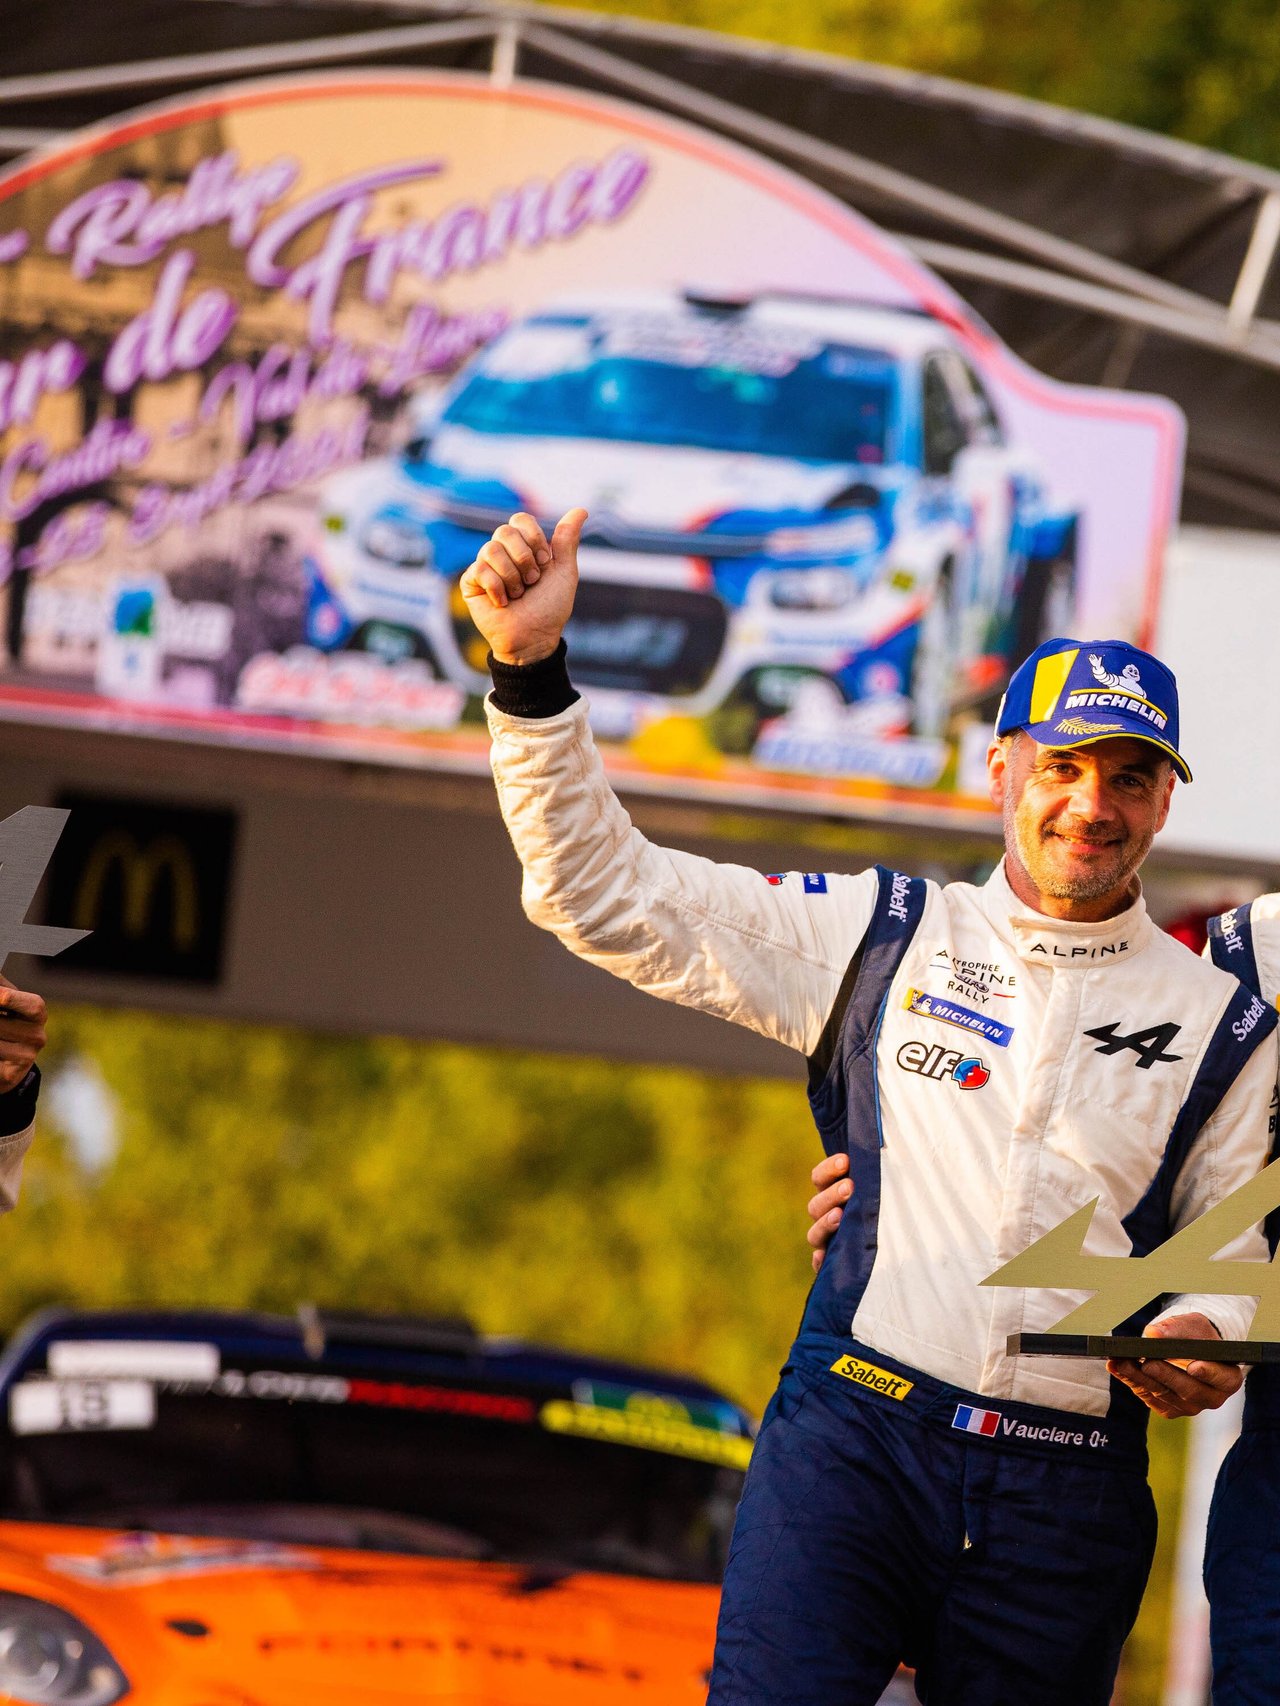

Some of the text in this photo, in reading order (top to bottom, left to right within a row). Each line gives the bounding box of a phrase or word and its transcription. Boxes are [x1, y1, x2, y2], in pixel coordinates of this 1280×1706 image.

[248, 161, 650, 348] France
[1065, 694, 1167, 731] MICHELIN
[1030, 941, 1129, 958] ALPINE
[947, 981, 990, 1004] RALLY
[932, 1005, 1003, 1038] MICHELIN
[1232, 995, 1266, 1041] Sabelt
[897, 1041, 959, 1081] elf
[841, 1360, 904, 1397] Sabelt
[1003, 1418, 1083, 1446] Vauclare
